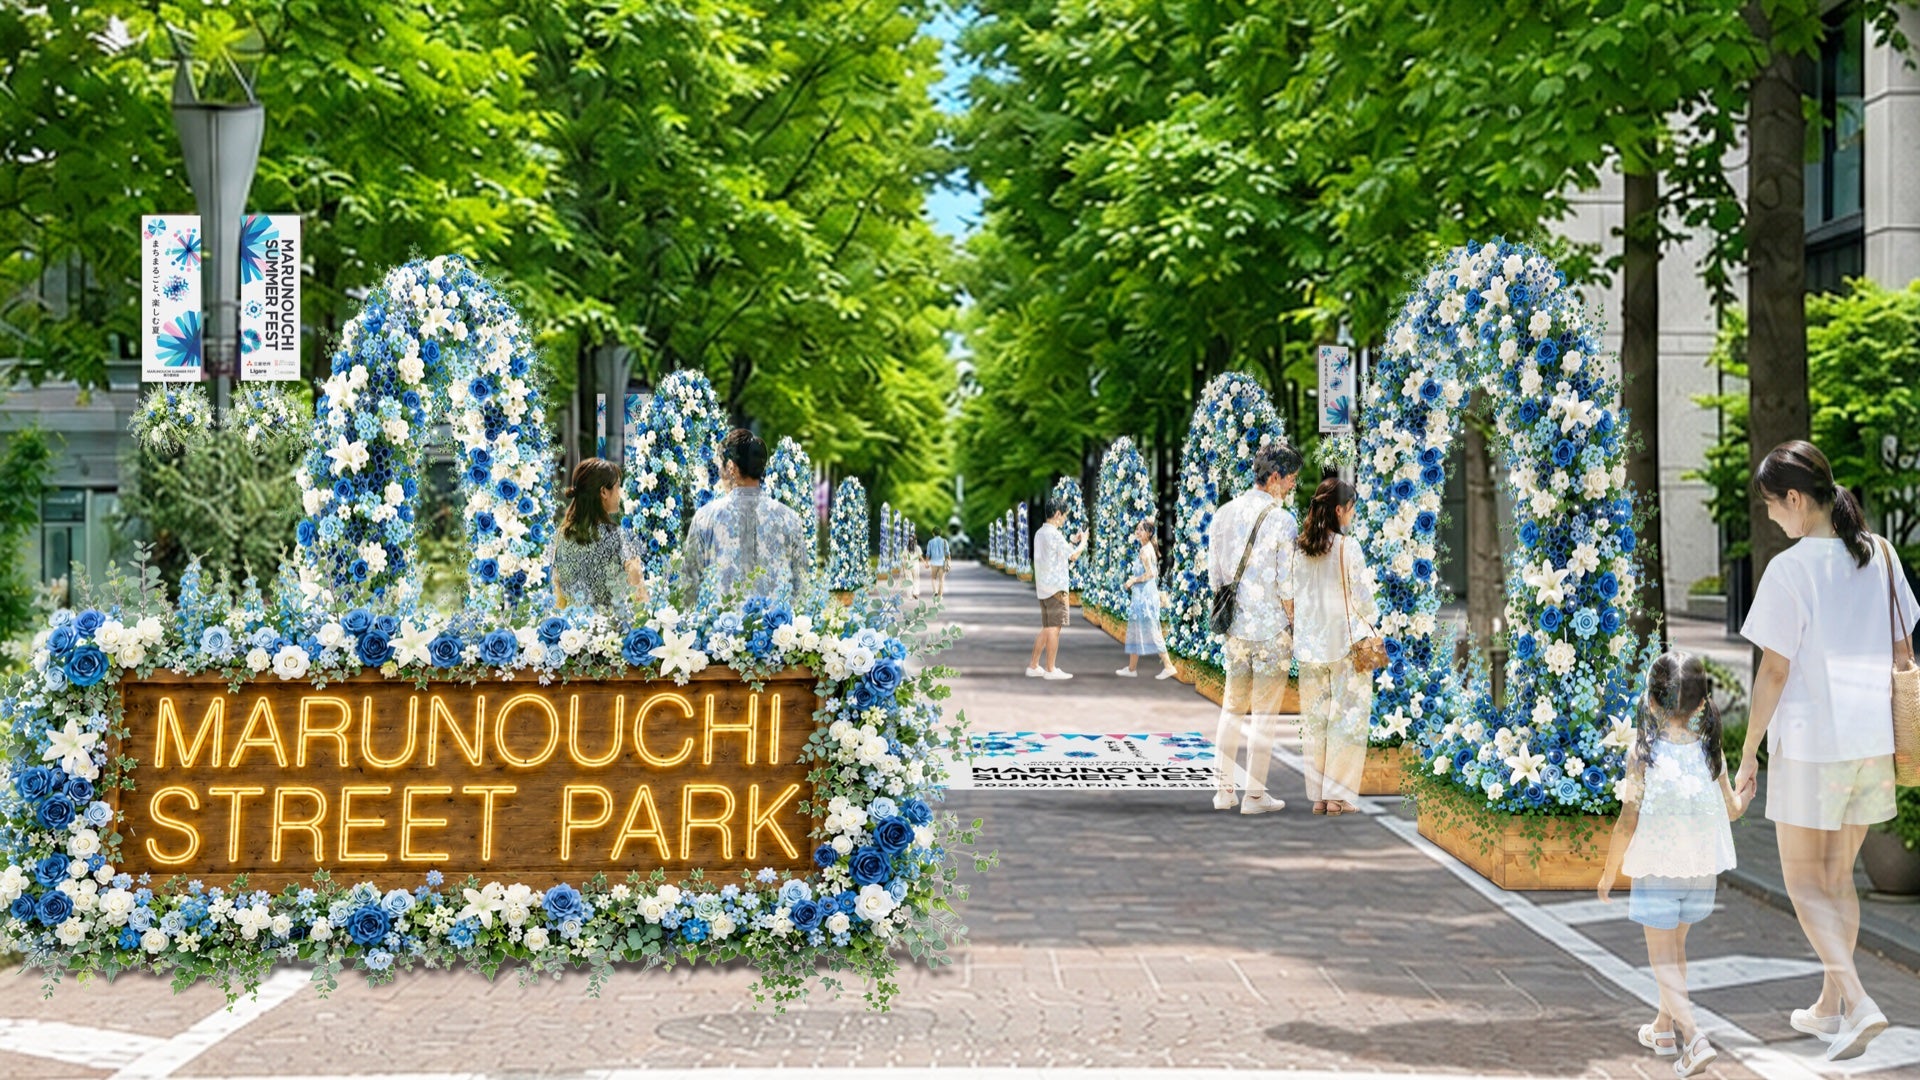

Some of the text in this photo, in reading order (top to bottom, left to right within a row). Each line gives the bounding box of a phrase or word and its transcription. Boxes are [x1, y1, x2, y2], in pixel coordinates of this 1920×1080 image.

[265, 239, 278, 351] SUMMER FEST
[281, 239, 294, 351] MARUNOUCHI
[154, 692, 782, 769] MARUNOUCHI
[145, 783, 801, 865] STREET PARK
